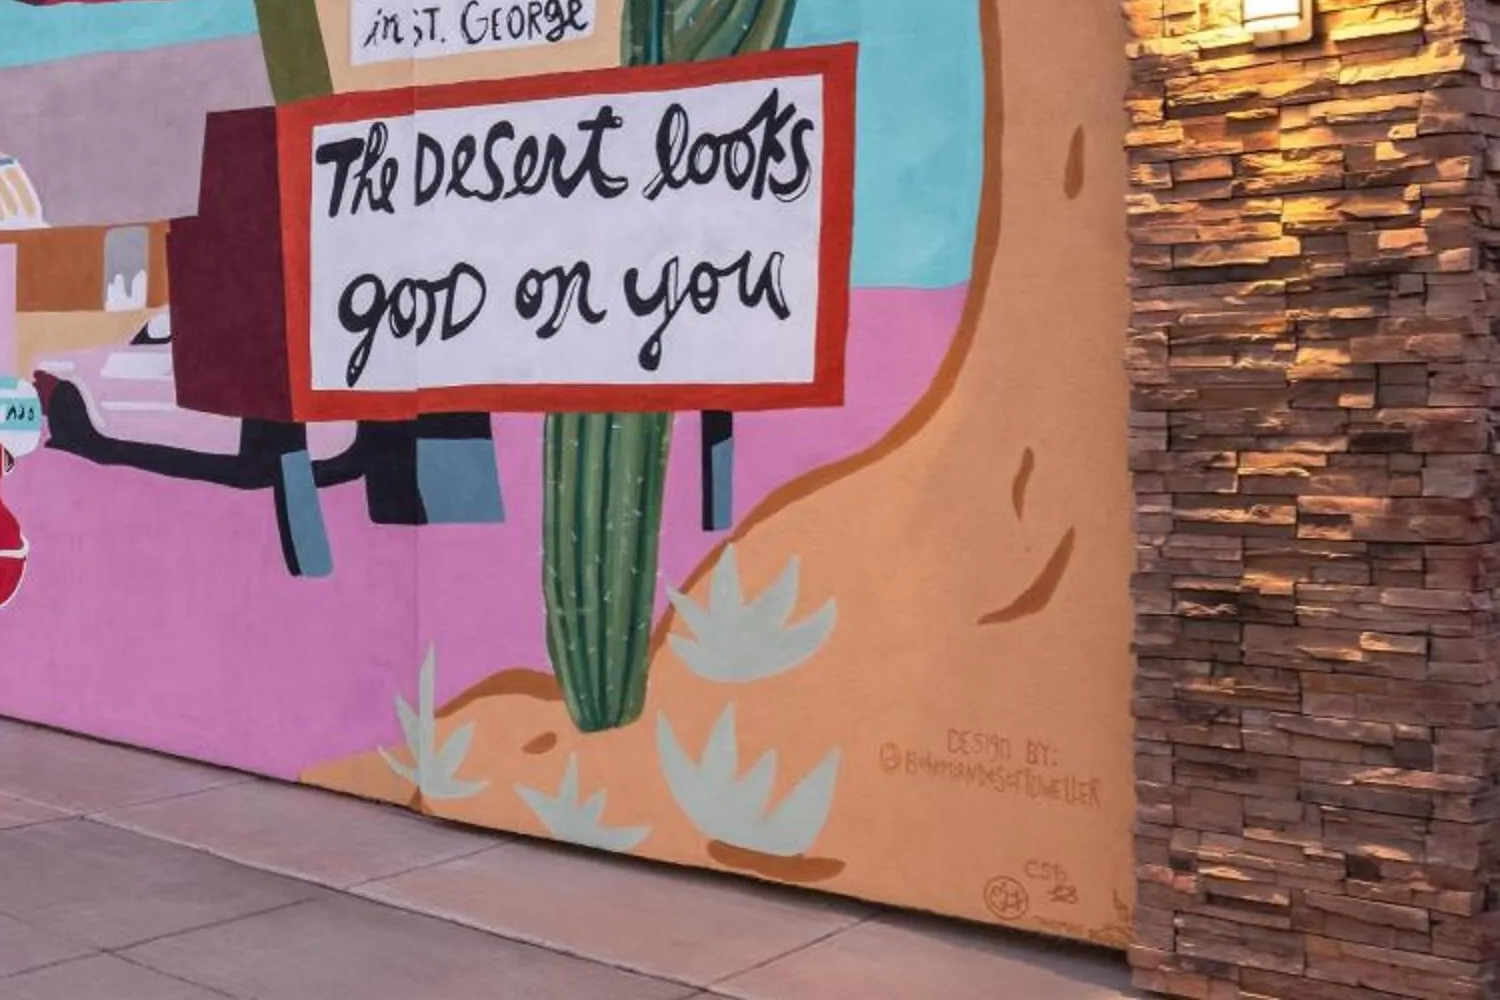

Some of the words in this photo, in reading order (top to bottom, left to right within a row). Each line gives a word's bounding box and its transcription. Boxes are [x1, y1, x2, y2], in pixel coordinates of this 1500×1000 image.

[363, 7, 404, 47] in
[315, 121, 398, 217] The
[642, 87, 814, 202] looks
[514, 261, 607, 339] on
[623, 251, 792, 371] you
[1026, 739, 1059, 766] BY:
